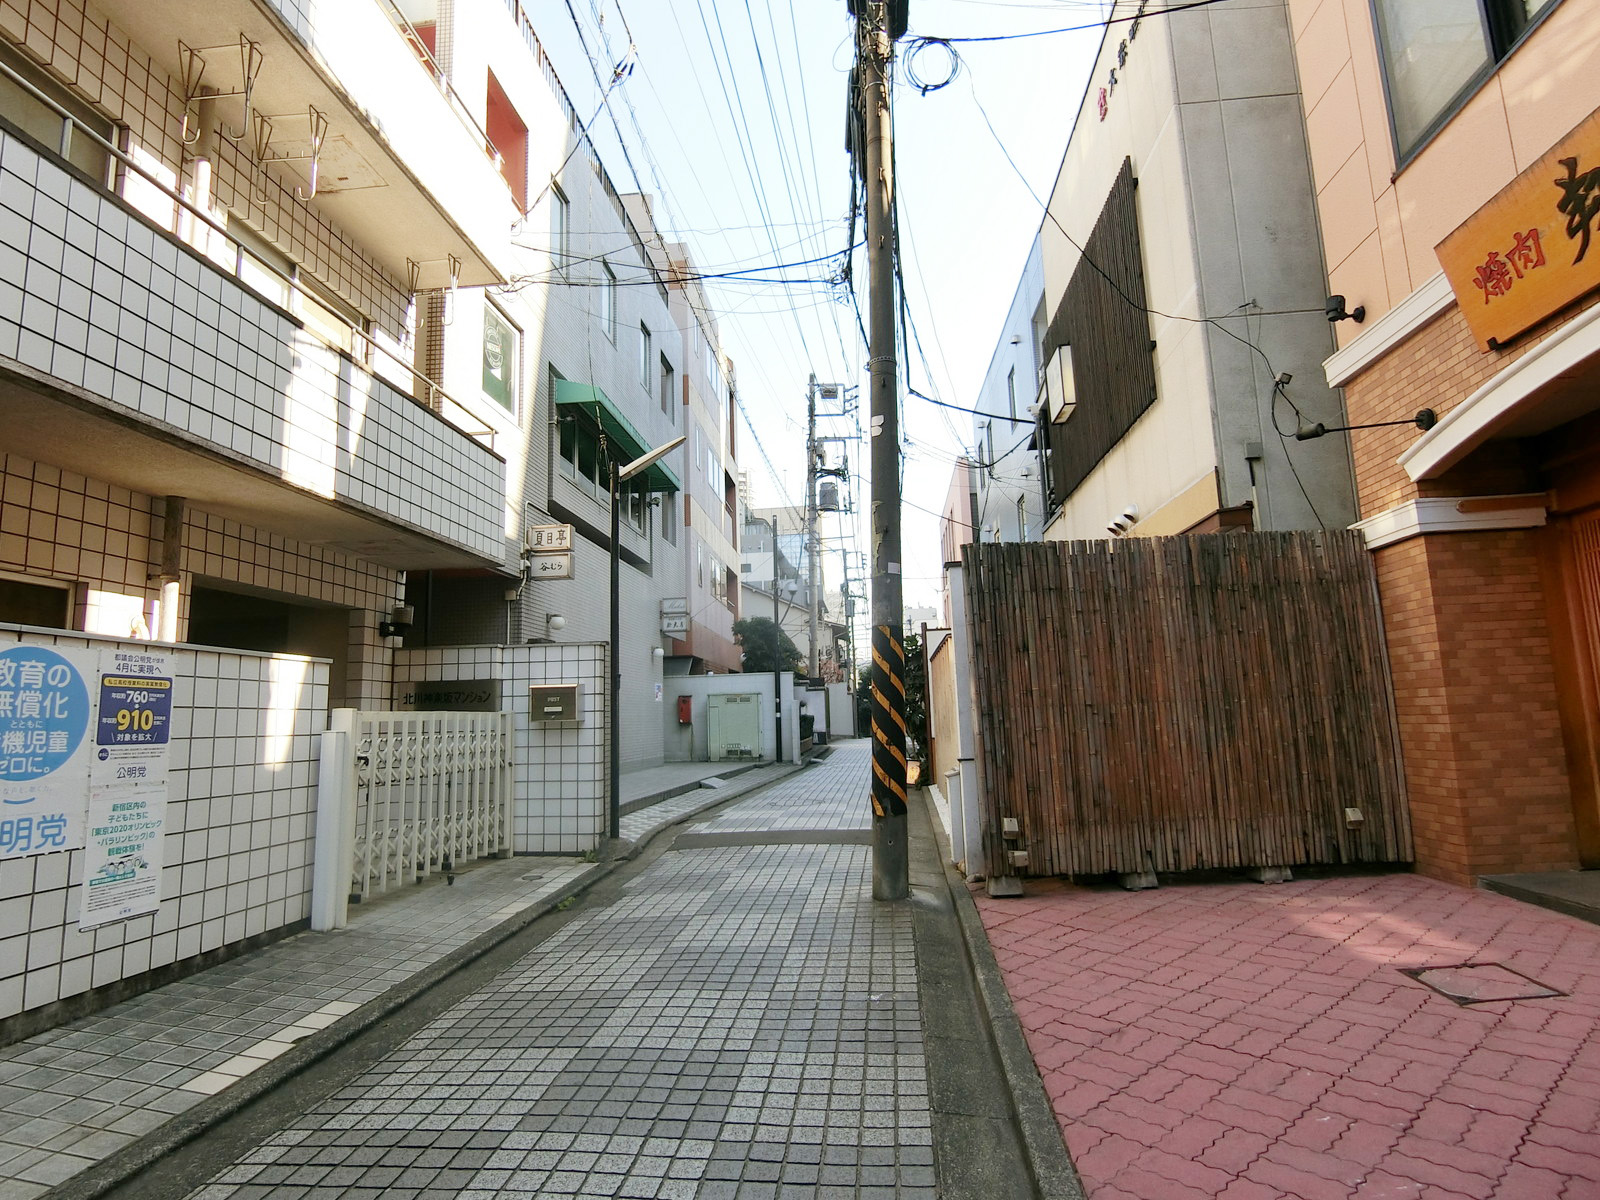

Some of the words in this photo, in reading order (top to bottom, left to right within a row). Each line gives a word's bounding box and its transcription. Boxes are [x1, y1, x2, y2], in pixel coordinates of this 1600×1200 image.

[1473, 228, 1545, 305] 焼肉
[0, 658, 71, 689] 教育の
[115, 663, 162, 675] 4月に実現へ
[126, 690, 148, 703] 760
[0, 690, 69, 719] 無償化
[10, 720, 43, 728] とともに
[117, 709, 154, 731] 910
[0, 730, 69, 754] 機児童
[117, 733, 152, 742] 対象を拡大
[117, 766, 147, 779] 公明党
[108, 812, 149, 824] 子どもたちに
